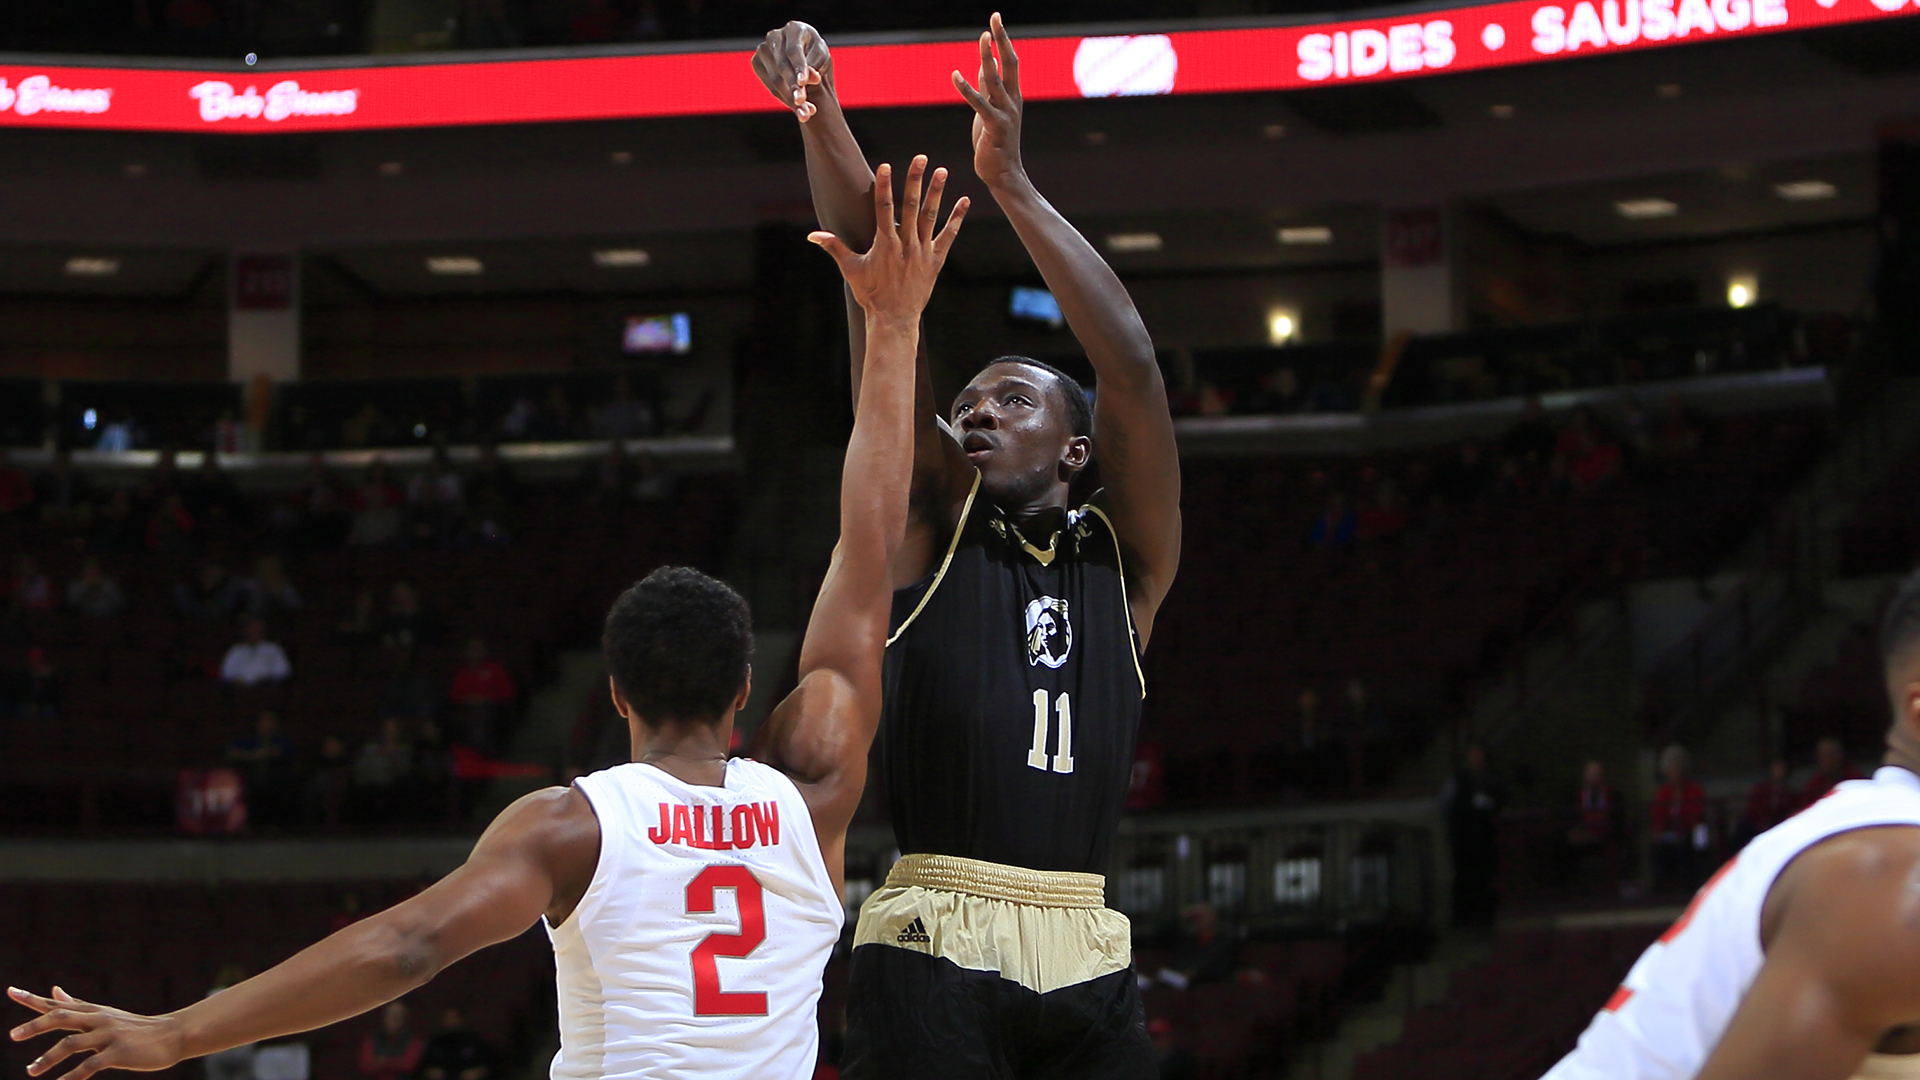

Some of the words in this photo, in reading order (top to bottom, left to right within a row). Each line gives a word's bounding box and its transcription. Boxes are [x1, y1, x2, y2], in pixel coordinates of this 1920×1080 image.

[1297, 20, 1456, 81] SIDES
[1531, 0, 1788, 54] SAUSAGE
[15, 75, 112, 116] Evans
[190, 81, 264, 121] Bob
[263, 81, 359, 121] Evans
[1027, 688, 1074, 774] 11
[648, 801, 779, 850] JALLOW
[684, 864, 769, 1017] 2
[897, 933, 931, 943] adidas
